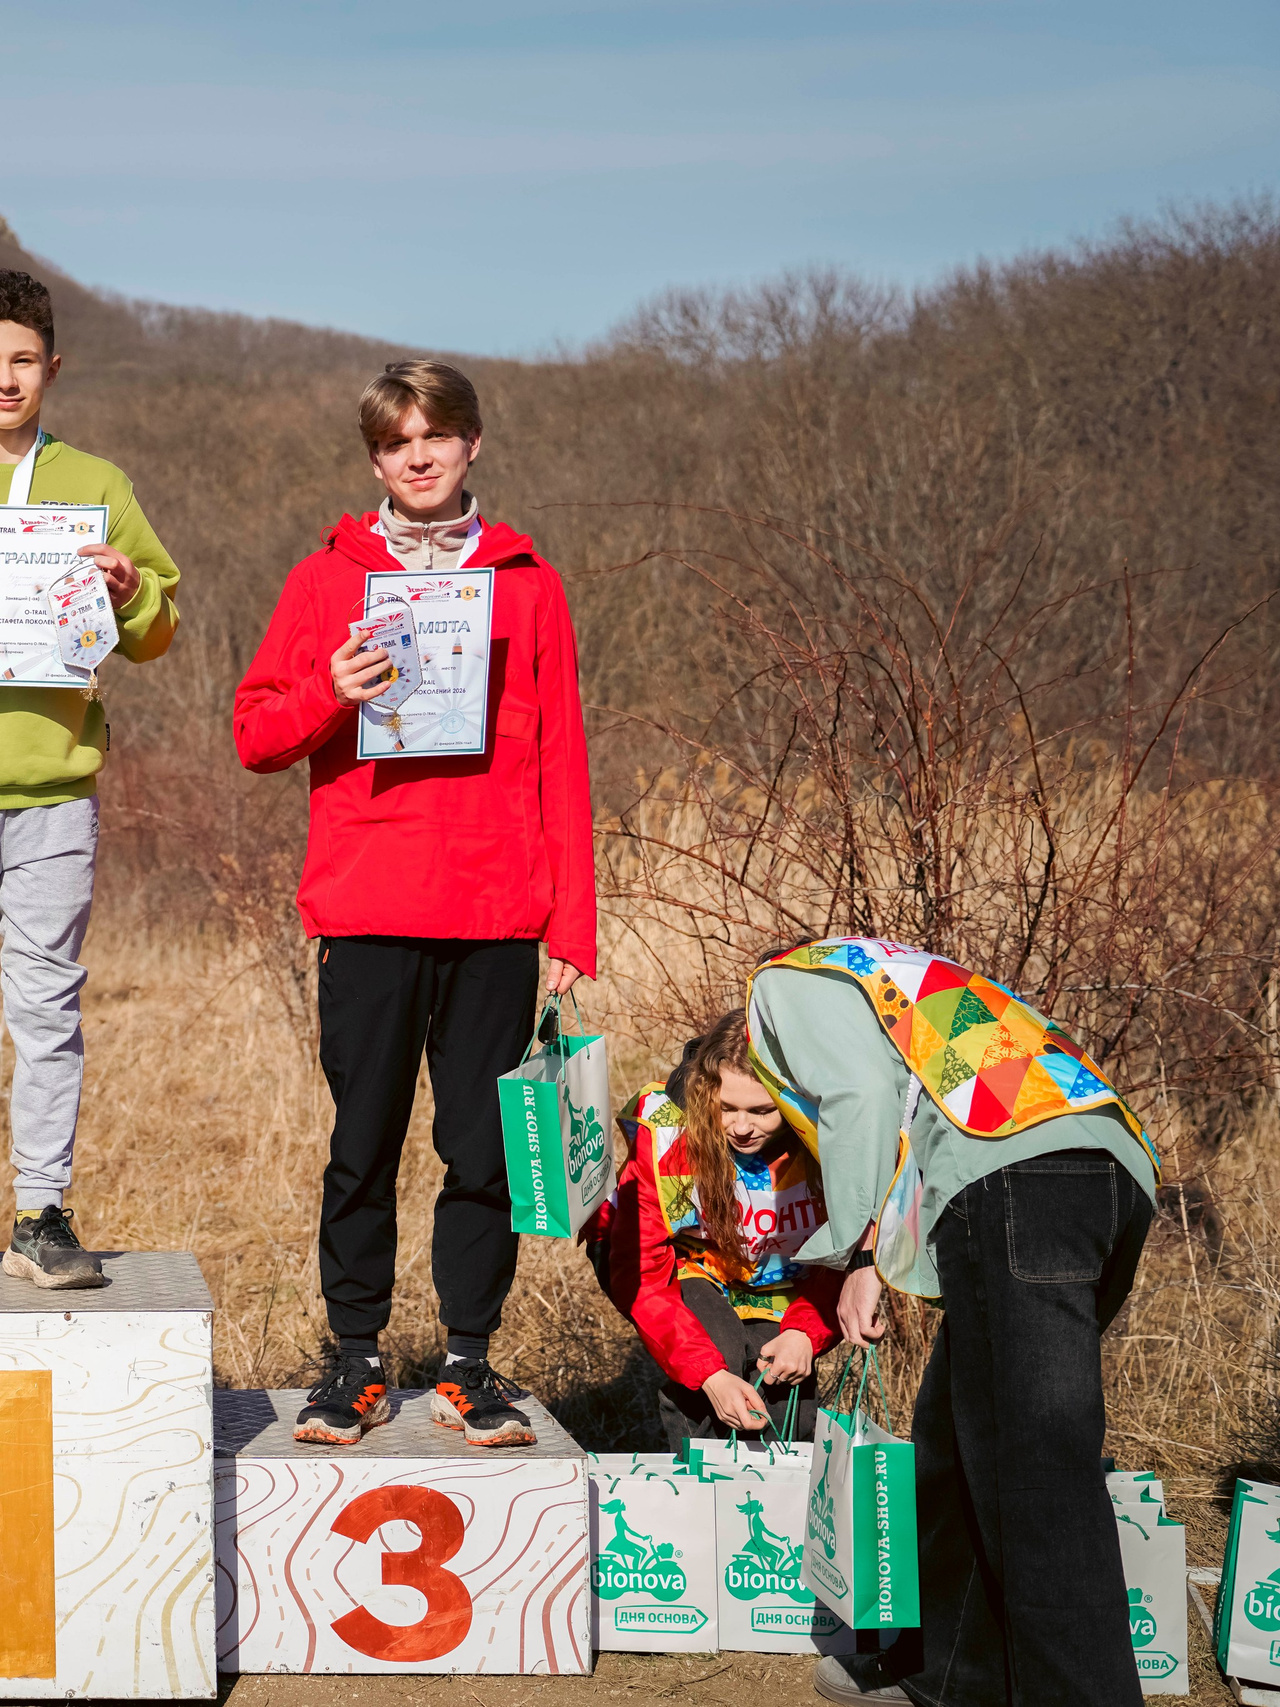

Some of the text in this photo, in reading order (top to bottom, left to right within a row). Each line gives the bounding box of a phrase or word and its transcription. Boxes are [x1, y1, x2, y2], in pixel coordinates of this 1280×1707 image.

[417, 620, 471, 634] МОТА
[523, 1085, 547, 1230] BIONOVA-SHOP.RU
[569, 1130, 604, 1175] bionova
[874, 1450, 893, 1622] BIONOVA-SHOP.RU
[330, 1485, 473, 1662] 3
[592, 1564, 685, 1591] bionova
[728, 1565, 807, 1591] bionov
[620, 1611, 698, 1624] ДНЯ ОСНОВА
[756, 1611, 836, 1627] ДНЯ ОСНОВА
[1136, 1659, 1170, 1670] НОВА
